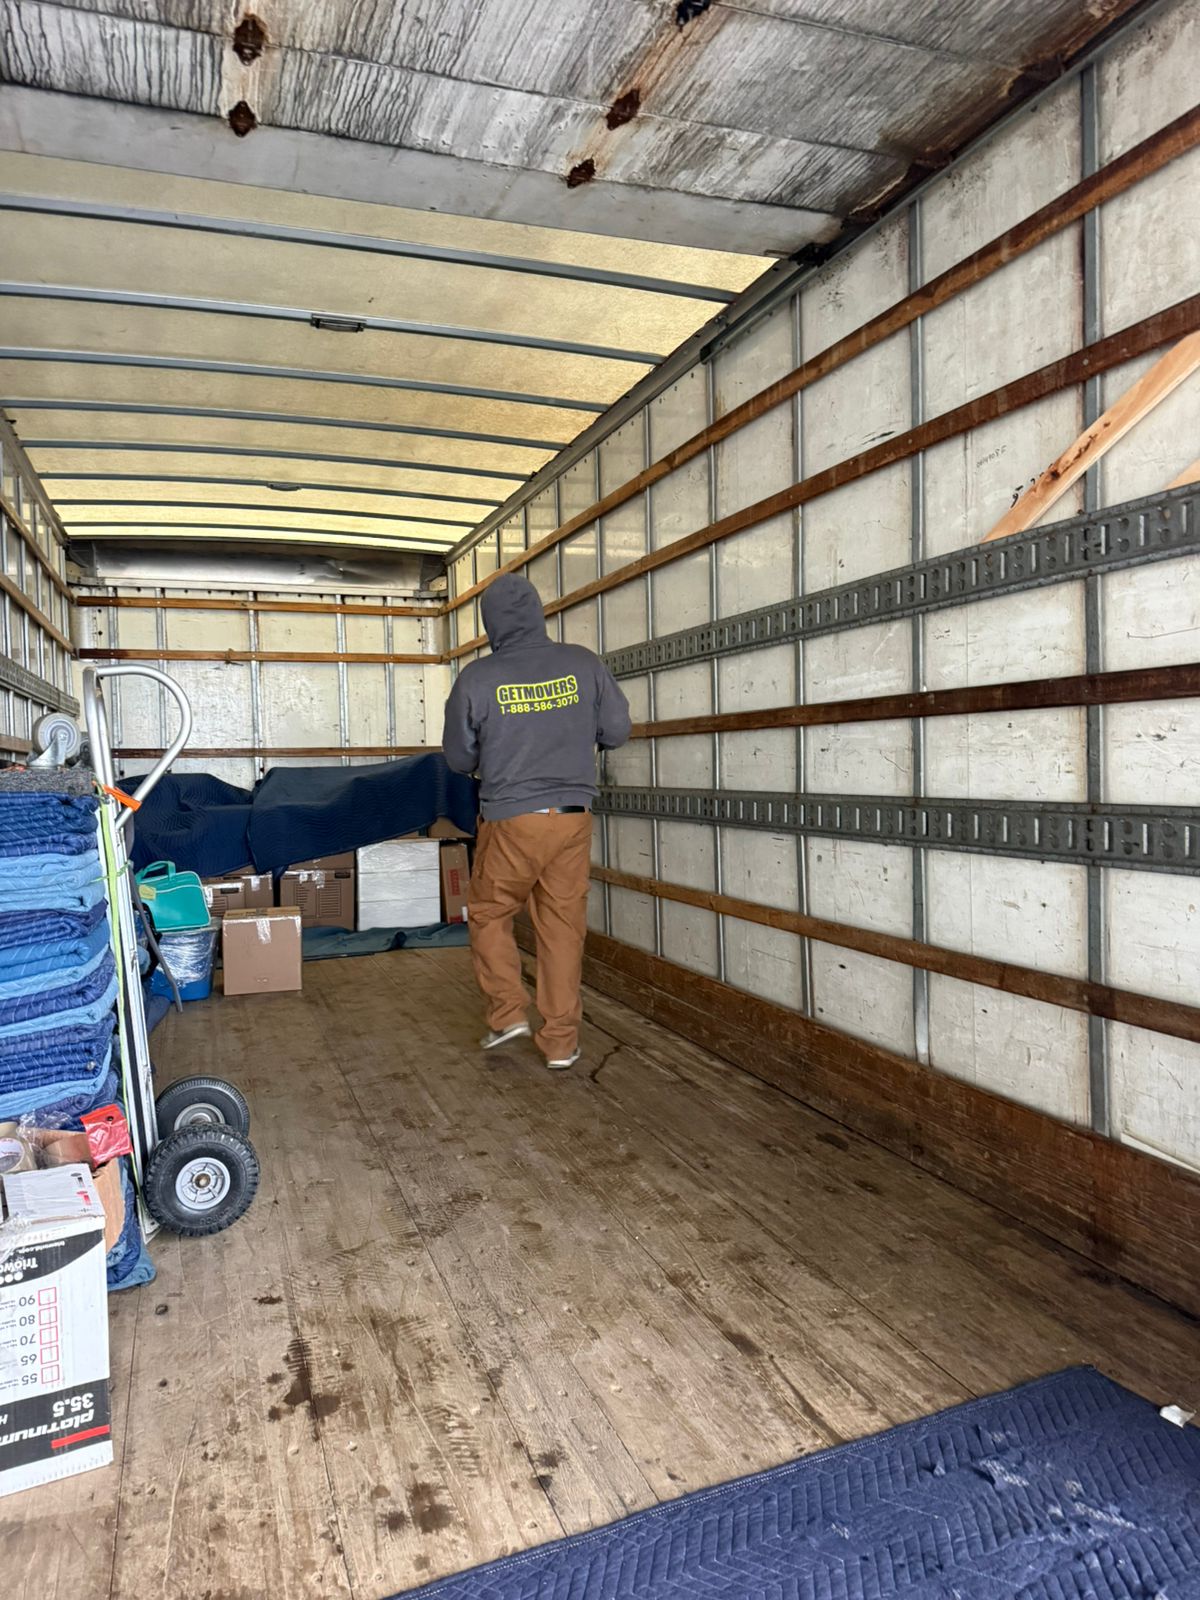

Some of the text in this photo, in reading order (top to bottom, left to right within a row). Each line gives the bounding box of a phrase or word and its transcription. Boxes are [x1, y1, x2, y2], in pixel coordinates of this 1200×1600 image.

[499, 676, 577, 702] GETMOVERS
[501, 694, 579, 715] 1-888-586-3070
[18, 1294, 36, 1307] 90
[19, 1314, 36, 1327] 80
[20, 1333, 36, 1346] 70
[20, 1353, 37, 1366] 65
[21, 1373, 38, 1386] 55
[53, 1392, 95, 1418] 35.5
